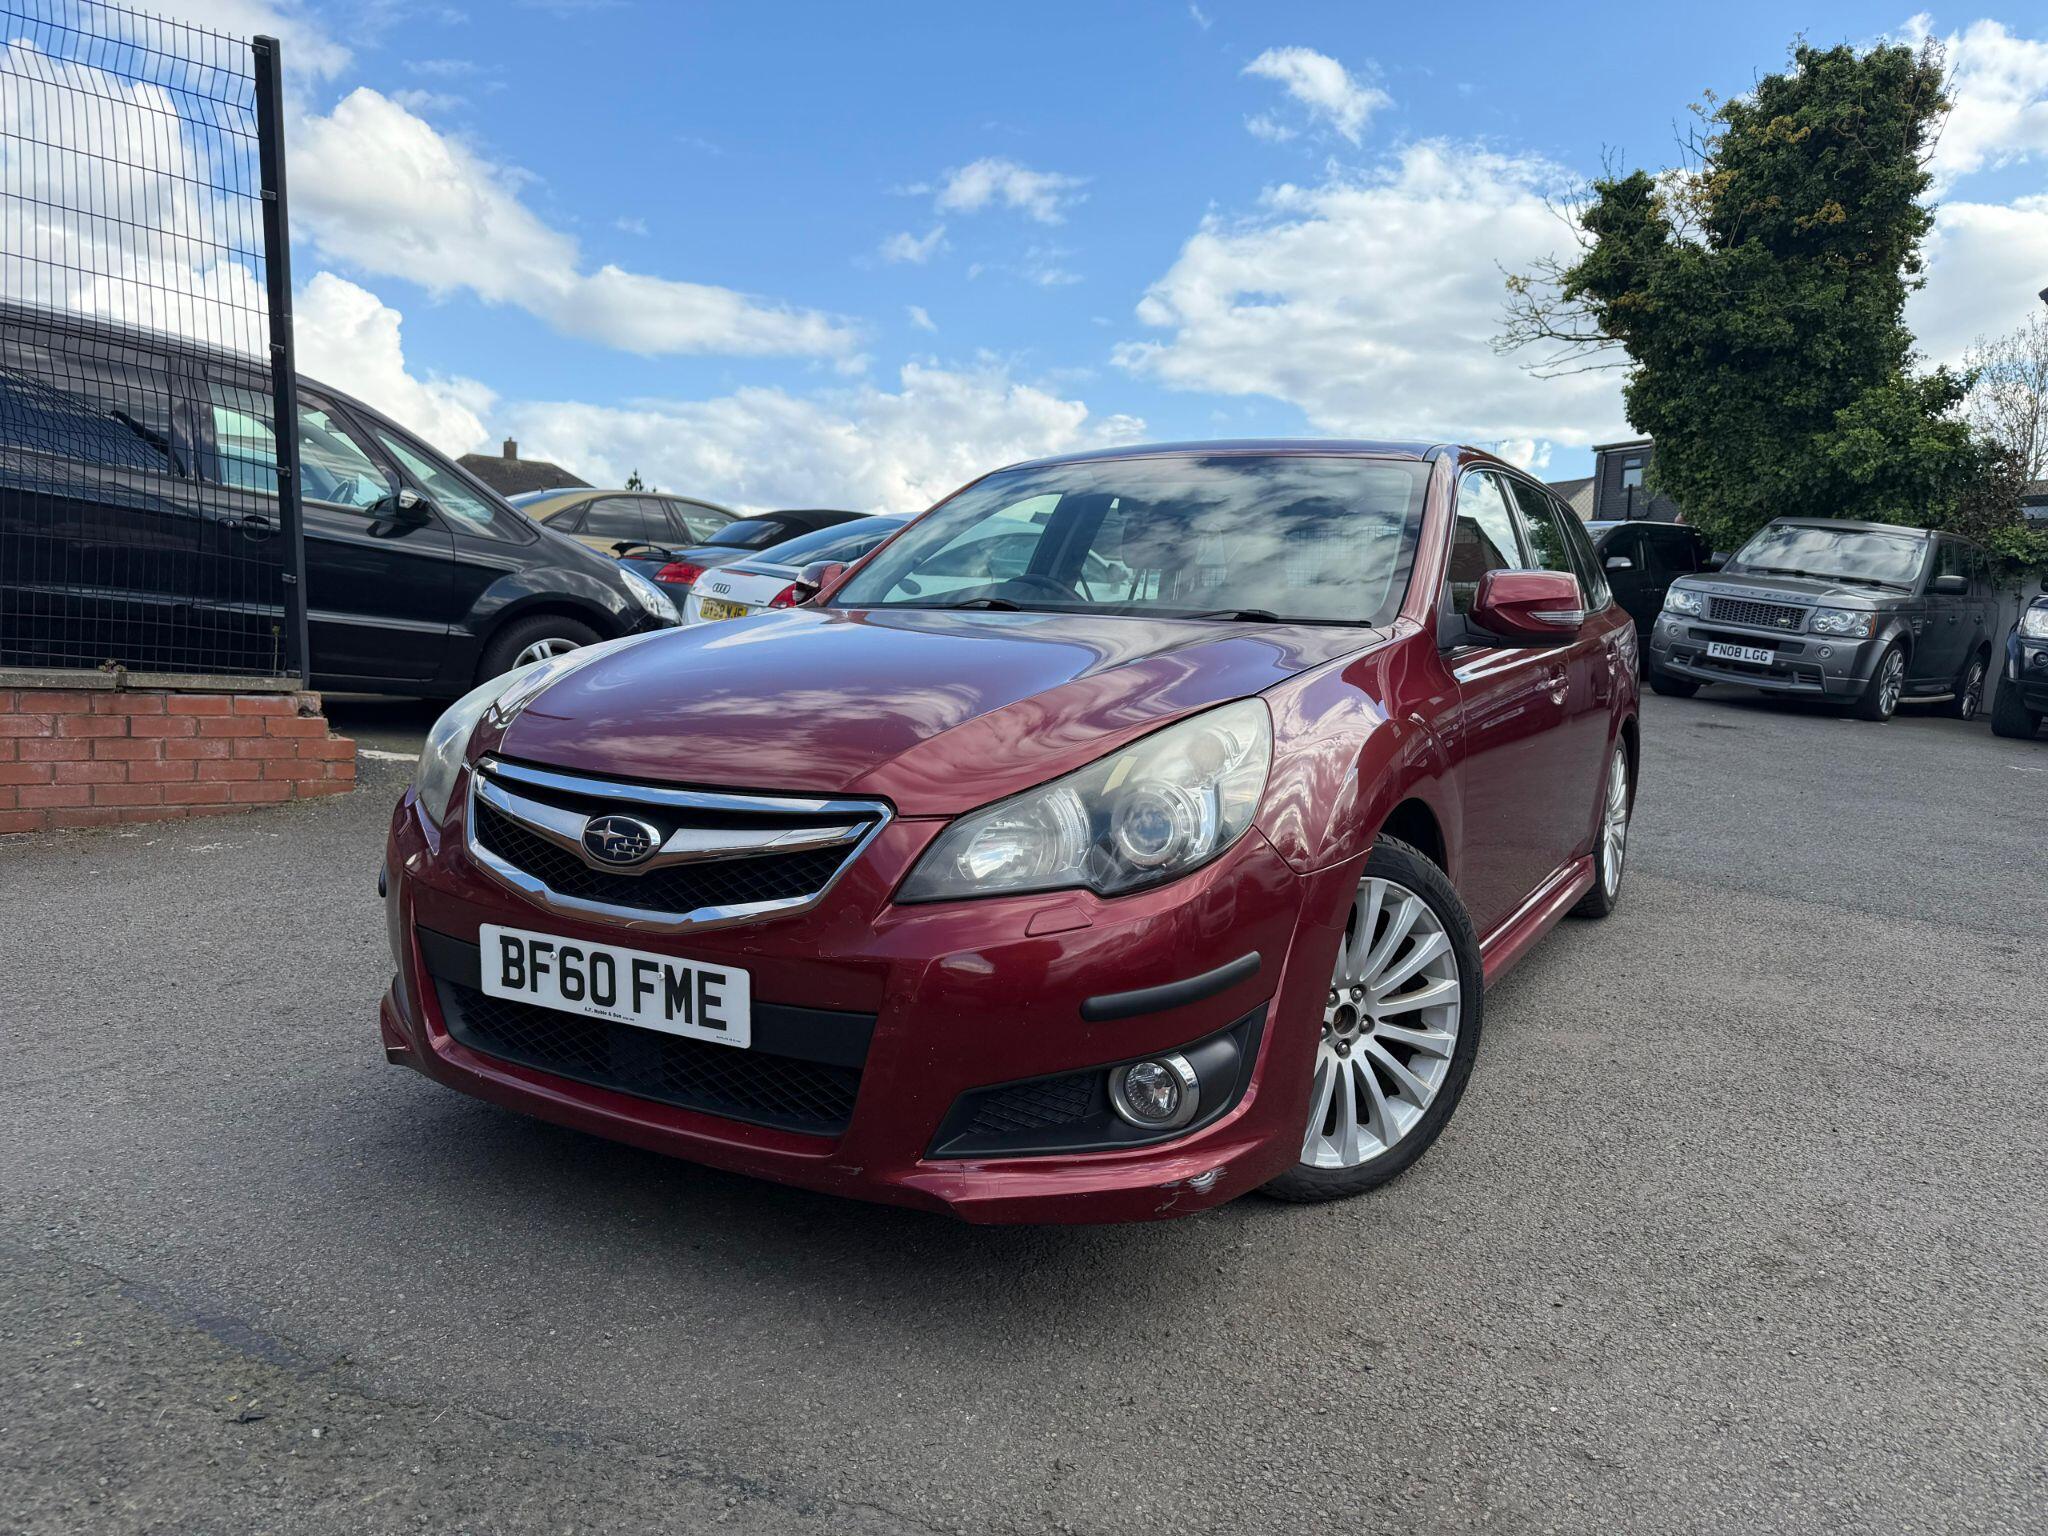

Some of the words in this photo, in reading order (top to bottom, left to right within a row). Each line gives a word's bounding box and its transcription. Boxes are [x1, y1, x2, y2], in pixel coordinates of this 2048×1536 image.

[1712, 644, 1742, 658] FN08
[1744, 649, 1768, 661] LGG
[1425, 867, 1472, 944] UNIROYAL
[500, 934, 616, 1007] BF60
[632, 959, 727, 1031] FME
